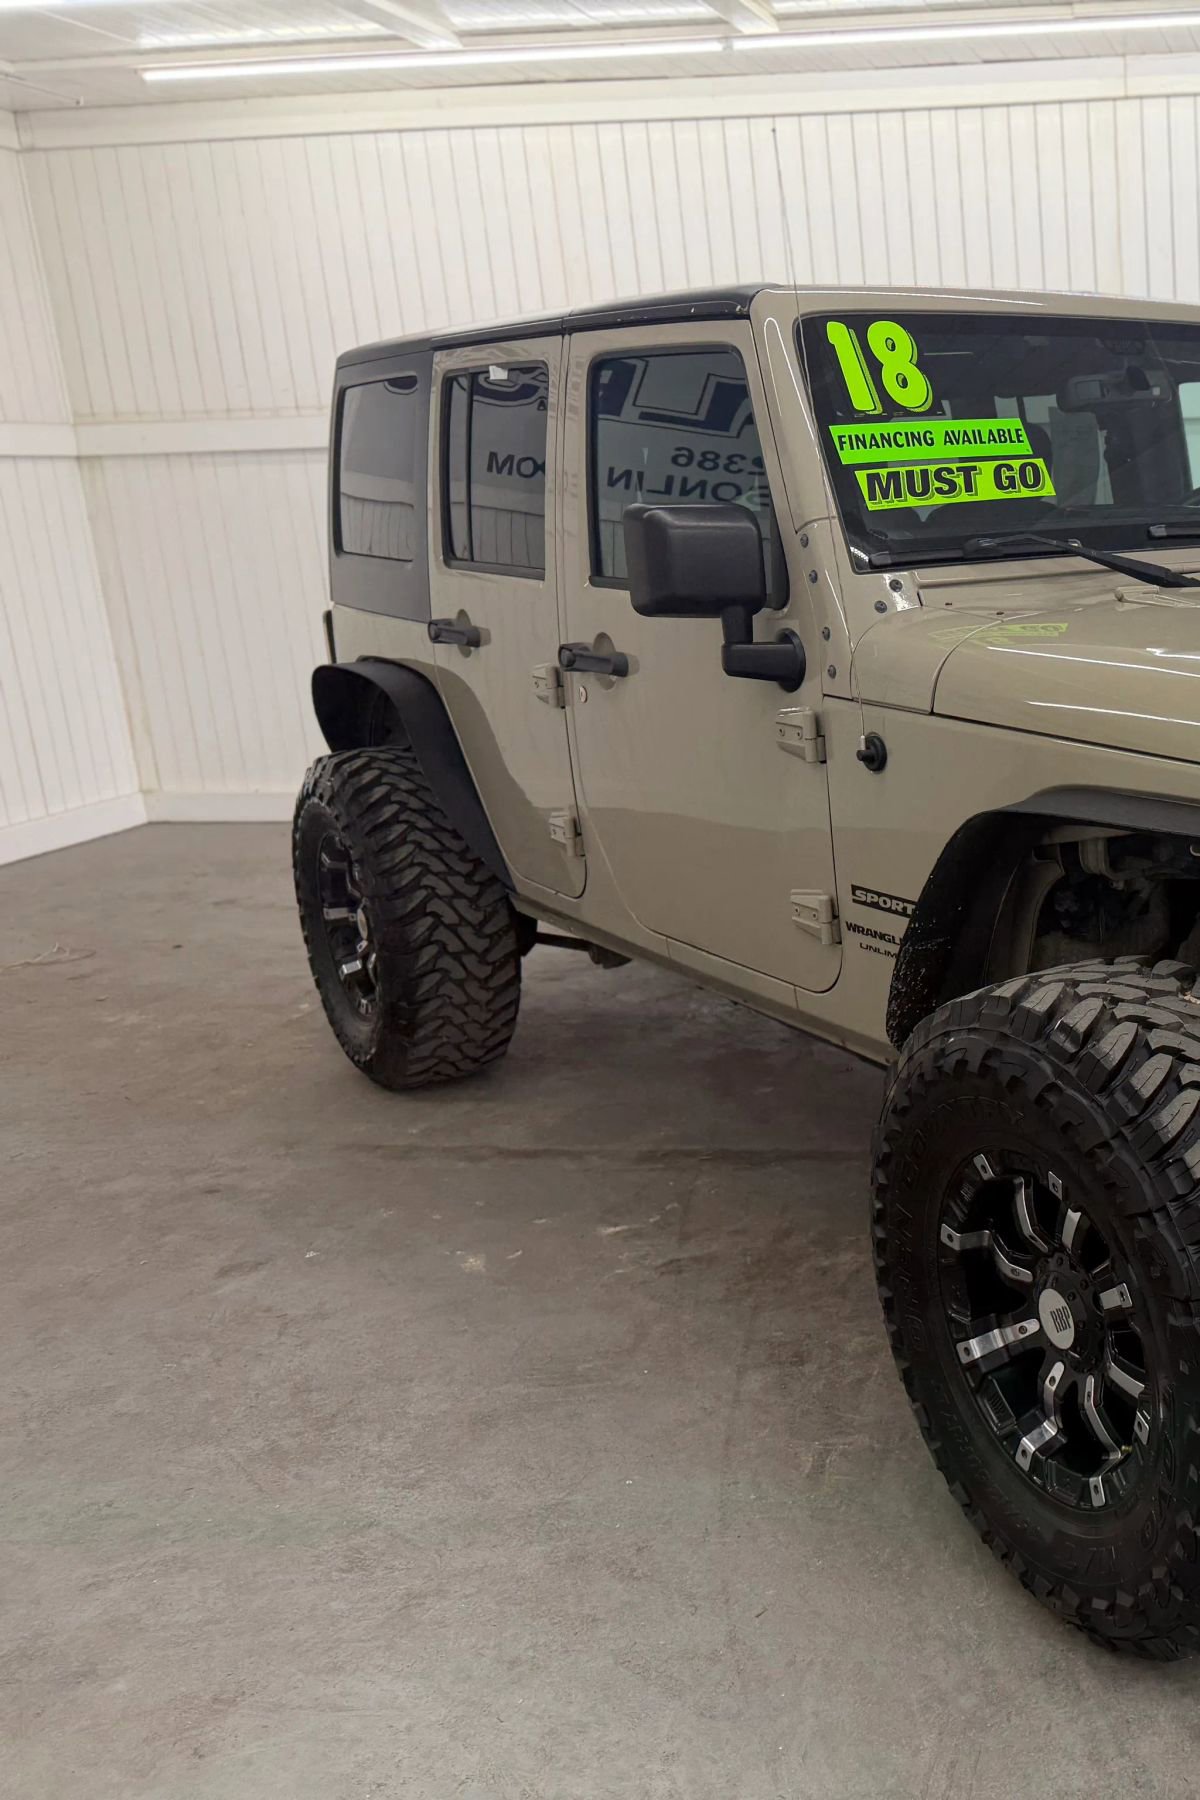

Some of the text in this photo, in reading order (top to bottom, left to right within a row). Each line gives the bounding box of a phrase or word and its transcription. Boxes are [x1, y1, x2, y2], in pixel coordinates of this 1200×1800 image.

[826, 320, 933, 414] 18
[837, 428, 1025, 451] FINANCING AVAILABLE
[866, 461, 1046, 504] MUST GO
[855, 889, 916, 915] SPORT
[845, 921, 902, 946] WRANGL
